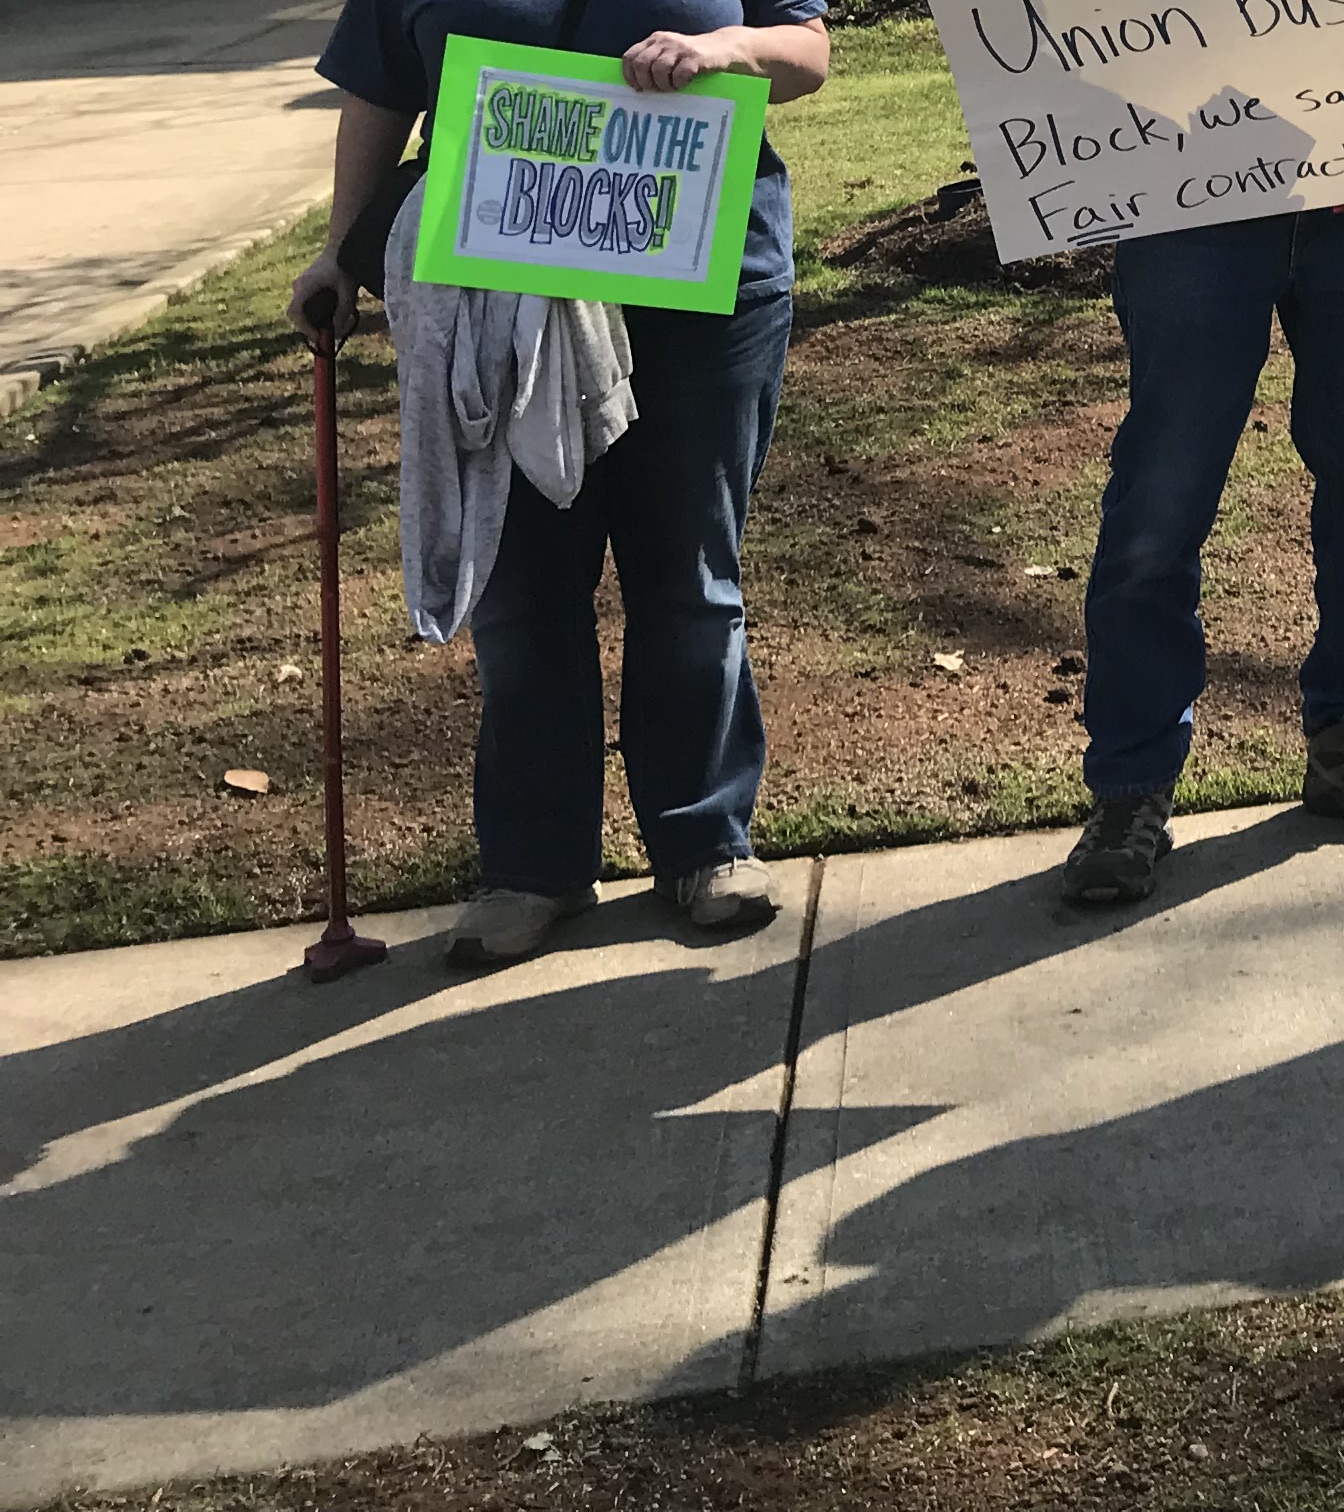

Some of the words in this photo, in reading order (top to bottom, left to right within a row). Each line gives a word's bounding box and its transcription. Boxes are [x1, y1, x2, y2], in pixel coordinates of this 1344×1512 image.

[484, 85, 606, 162] SHAME
[602, 107, 652, 169] ON
[652, 114, 709, 171] THE
[999, 102, 1186, 180] Block,
[1198, 97, 1278, 134] we
[499, 158, 678, 254] BLOCKS!
[1028, 180, 1148, 242] Fair
